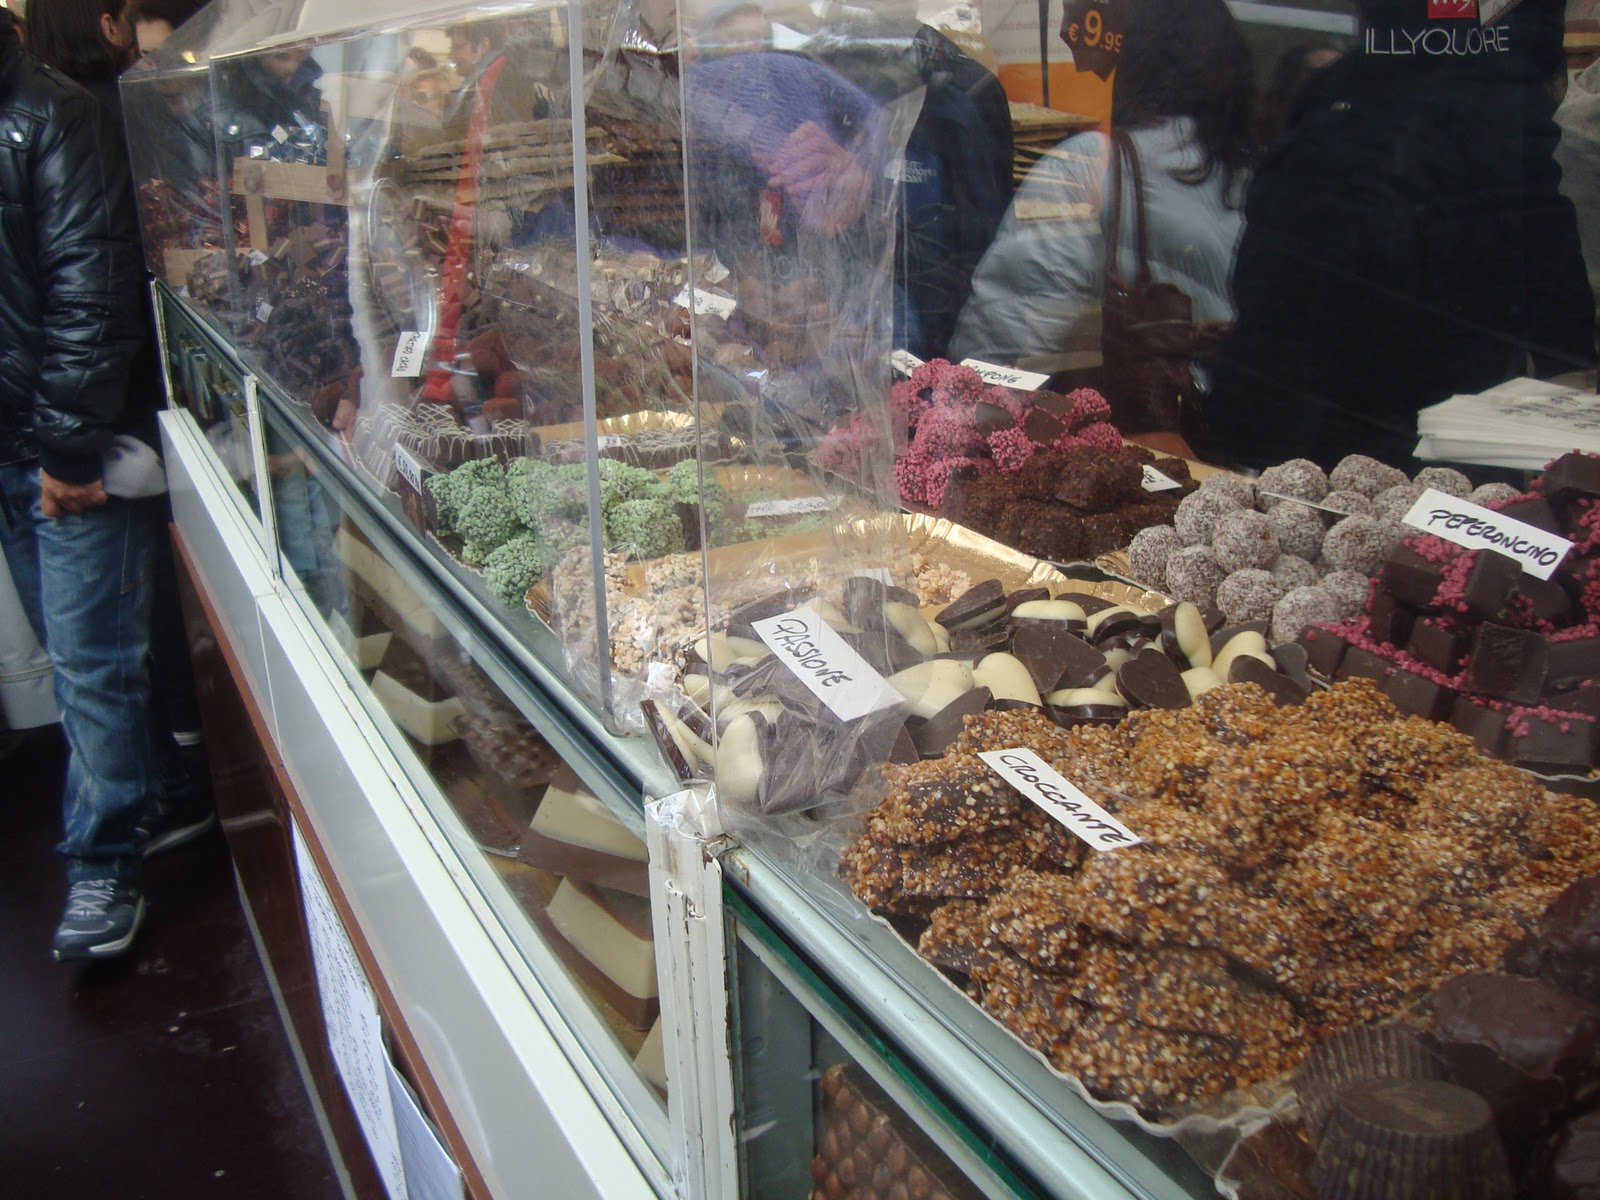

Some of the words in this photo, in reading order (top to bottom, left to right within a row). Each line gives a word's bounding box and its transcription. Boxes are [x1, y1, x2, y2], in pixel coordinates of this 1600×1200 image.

[1068, 22, 1079, 42] €
[1365, 26, 1509, 56] ILLYQUORE
[1427, 509, 1558, 566] PEPERONCINO
[772, 618, 853, 687] PASSIONE
[999, 754, 1132, 843] CROCCANTE
